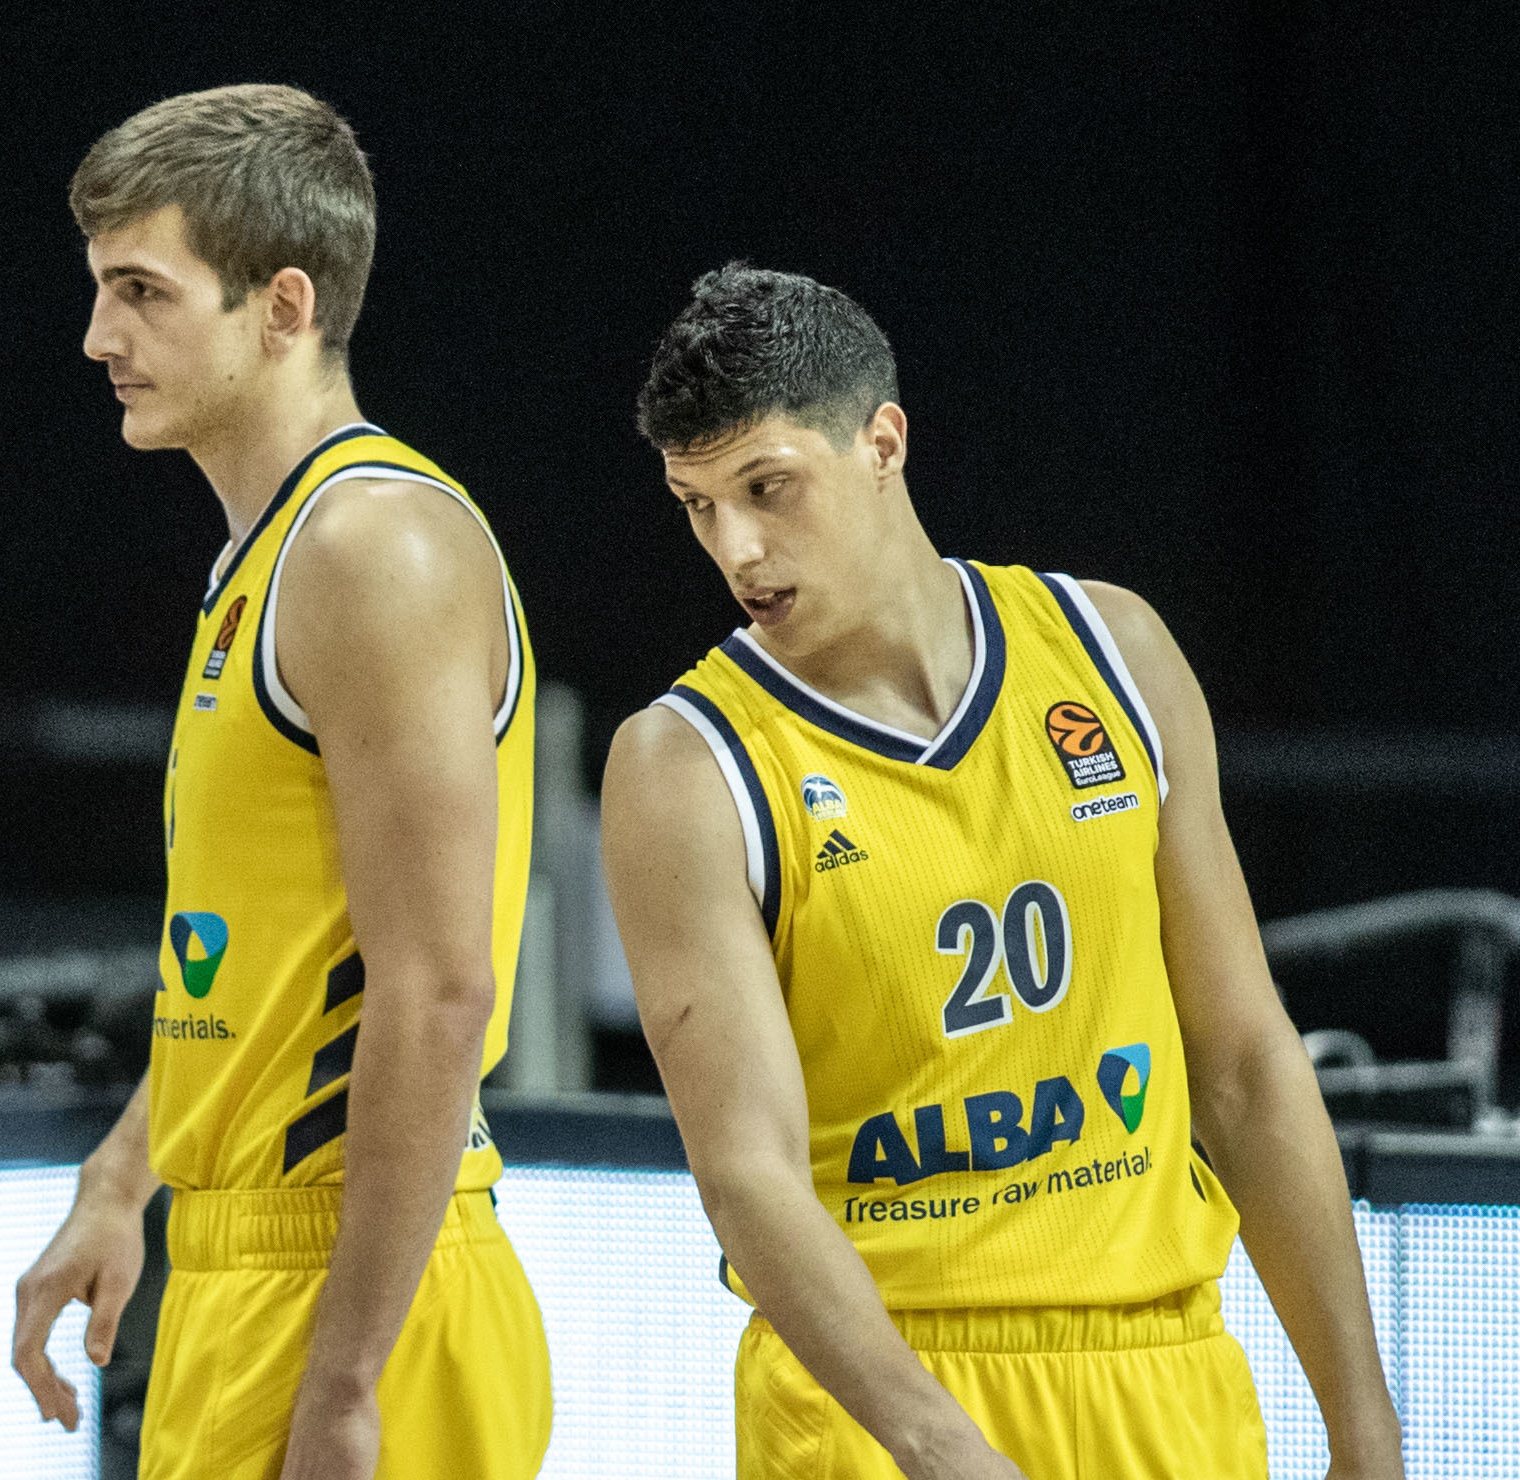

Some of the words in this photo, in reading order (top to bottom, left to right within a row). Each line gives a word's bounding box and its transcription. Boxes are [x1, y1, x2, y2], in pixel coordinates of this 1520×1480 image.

[1068, 751, 1114, 770] TURKISH
[1073, 760, 1118, 778] AIRLINES
[1072, 793, 1139, 820] oneteam
[814, 850, 869, 872] adidas
[935, 879, 1073, 1040] 20
[847, 1075, 1085, 1187] ALBA
[844, 1196, 980, 1223] Treasure
